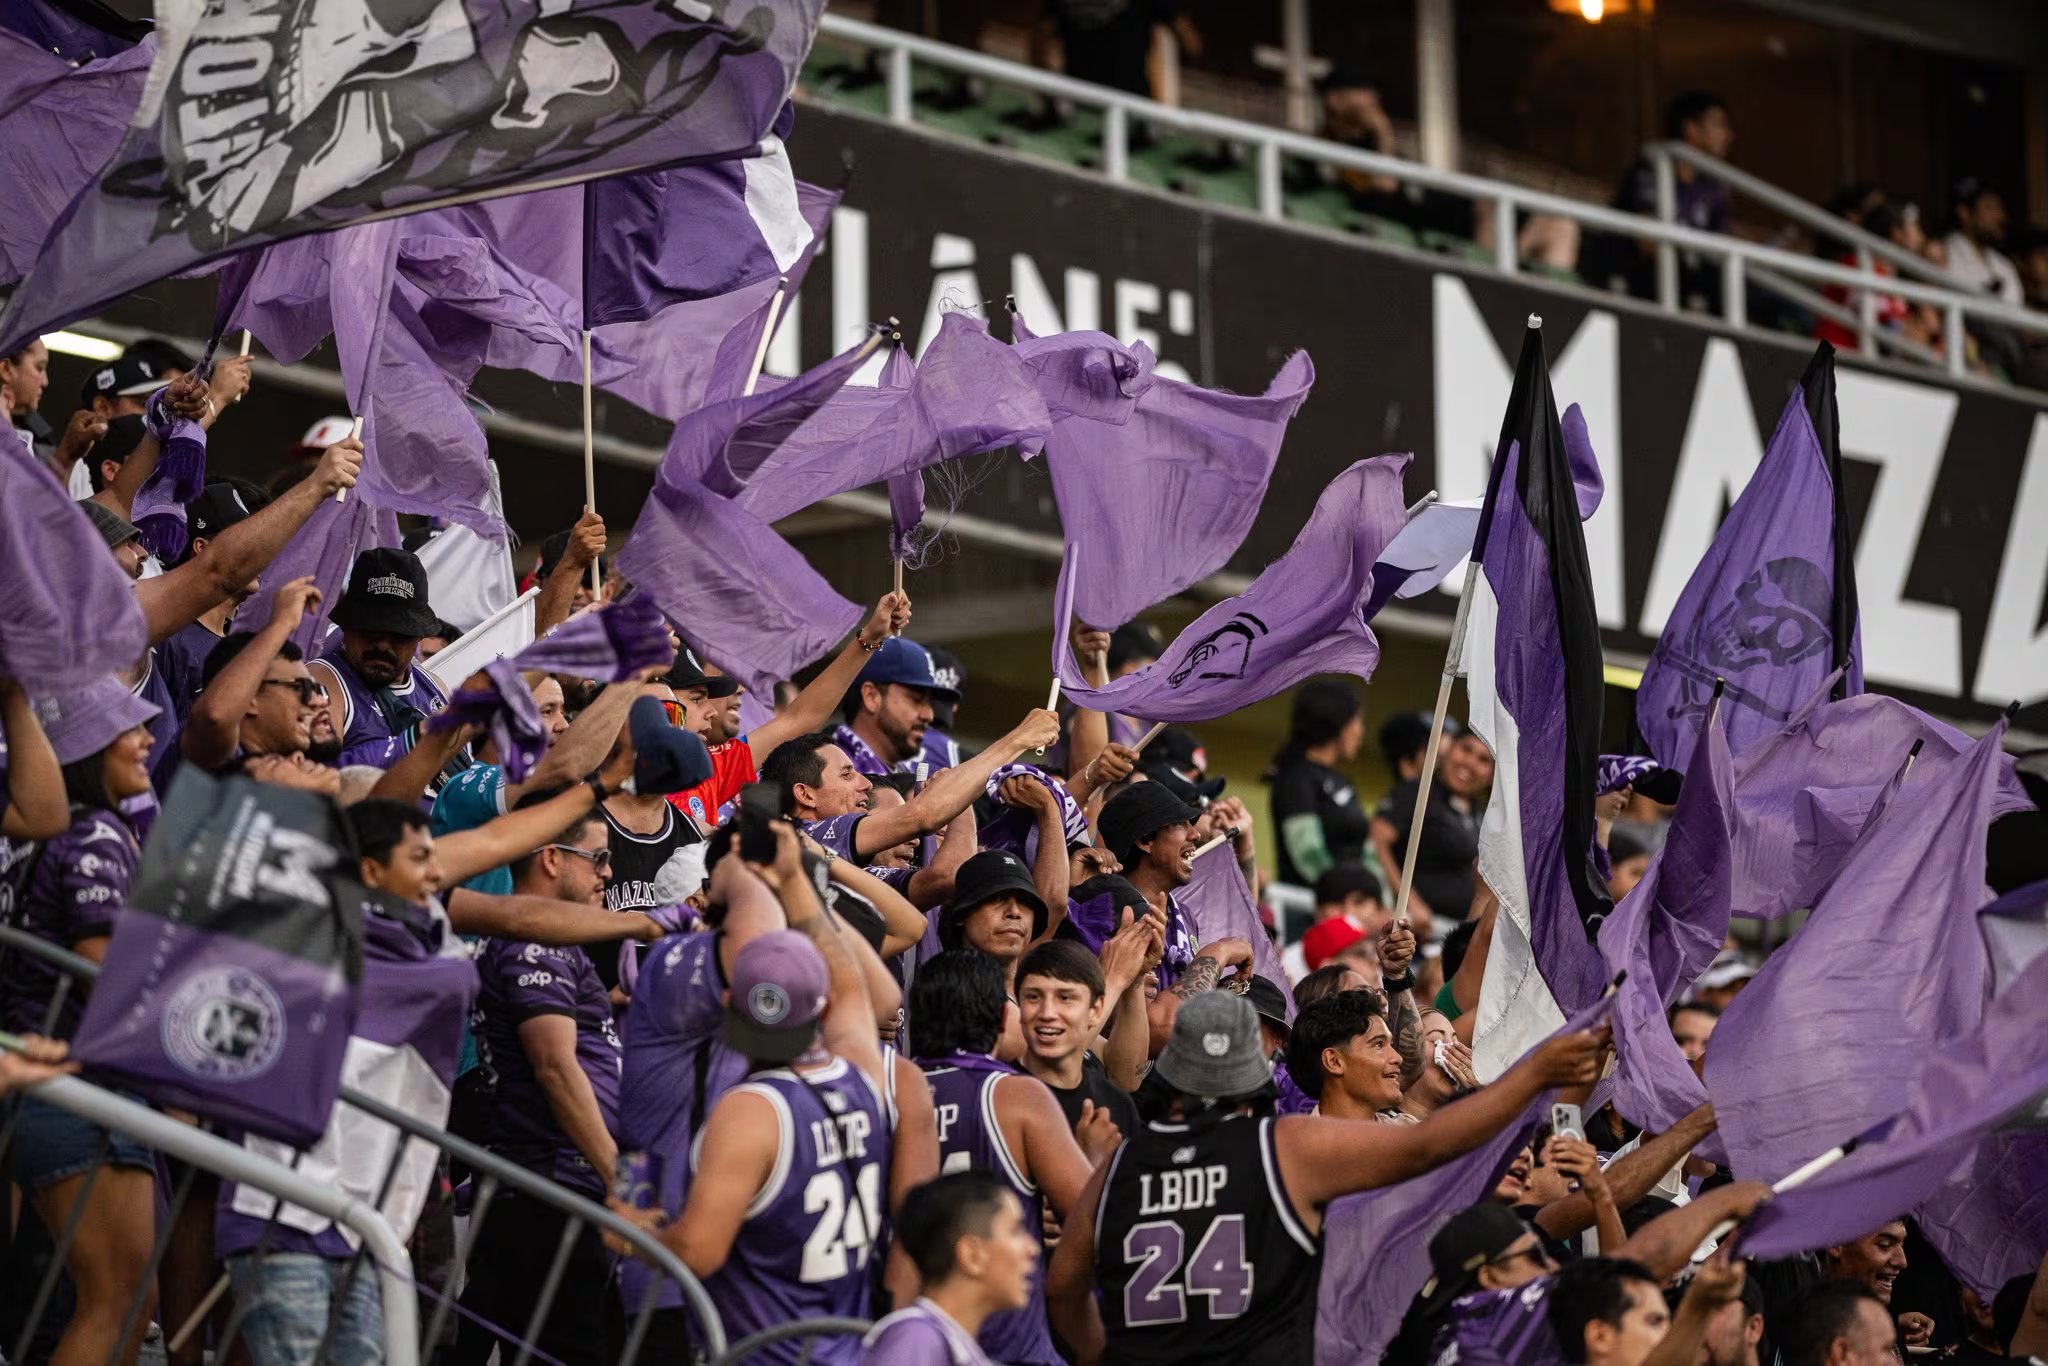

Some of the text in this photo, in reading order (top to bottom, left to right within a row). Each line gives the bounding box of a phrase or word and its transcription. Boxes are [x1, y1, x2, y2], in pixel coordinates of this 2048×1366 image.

[517, 970, 552, 987] exp
[799, 1162, 883, 1283] 24
[1138, 1164, 1228, 1216] LBDP
[1123, 1213, 1255, 1328] 24
